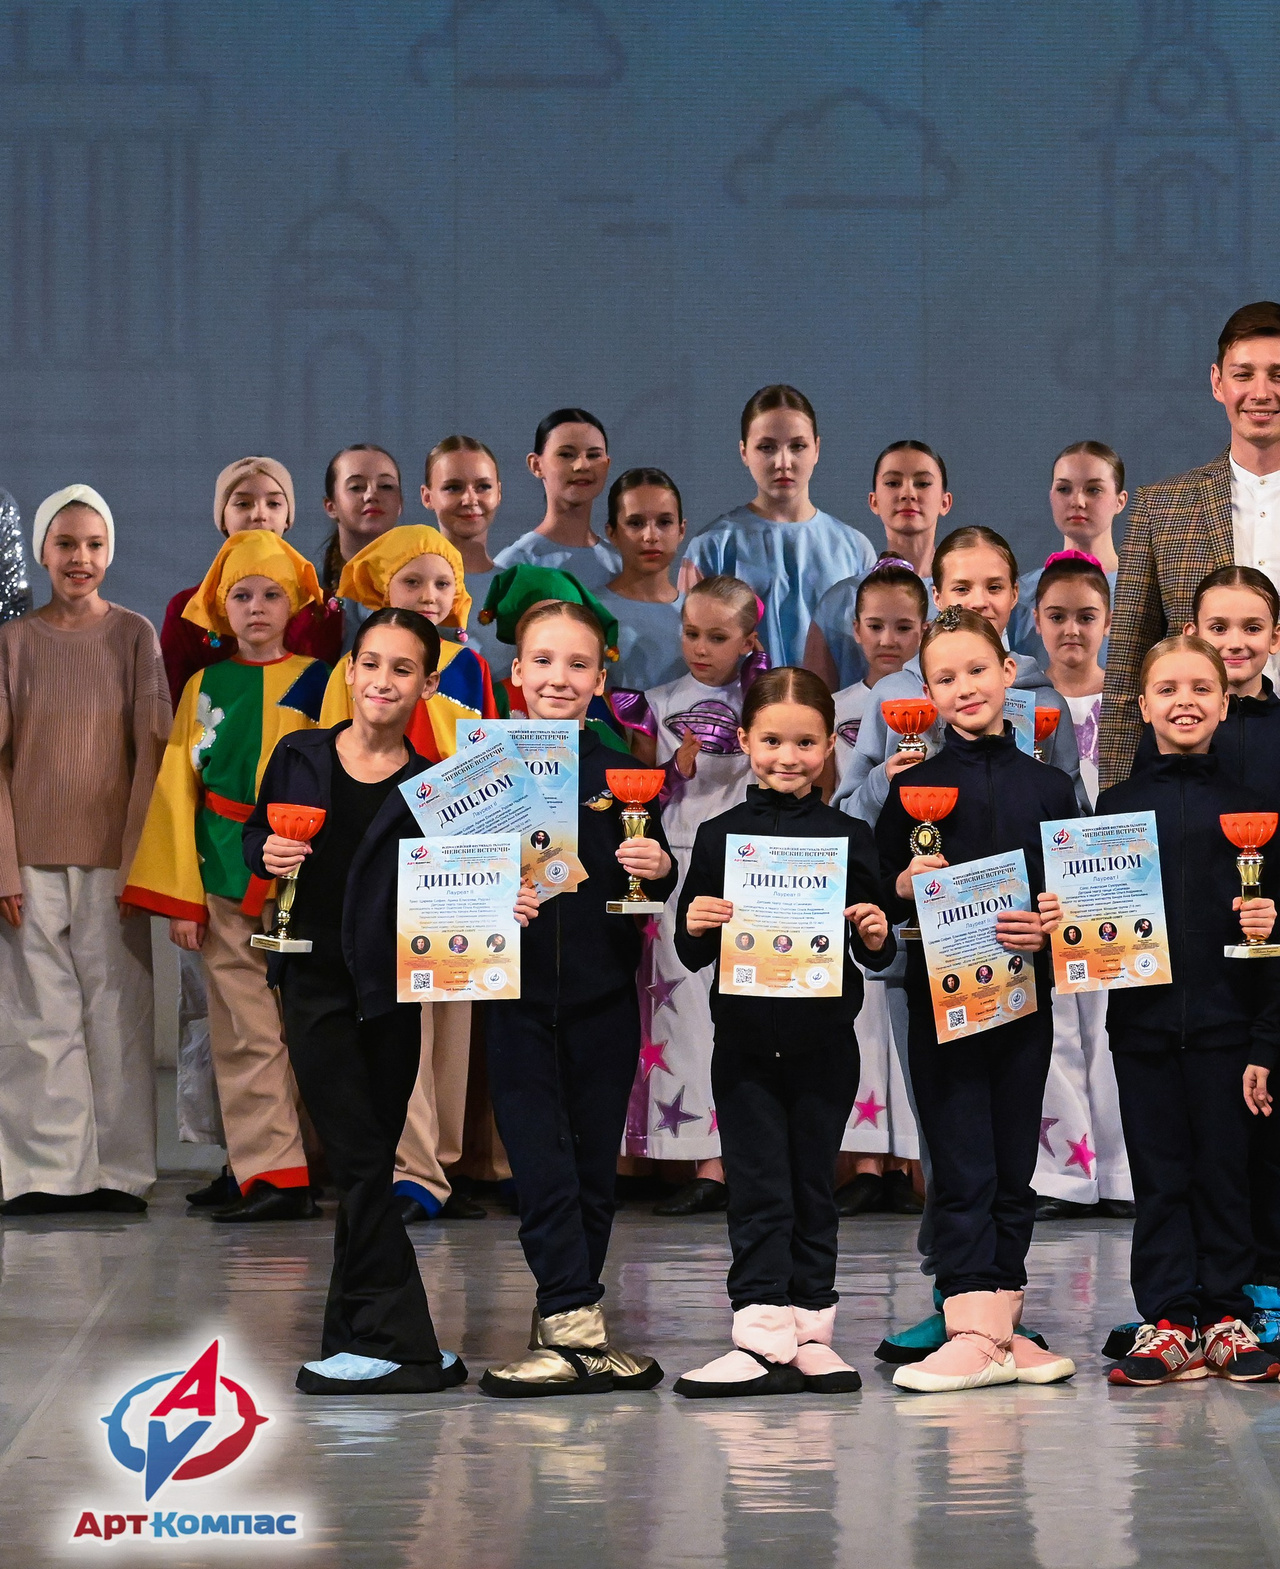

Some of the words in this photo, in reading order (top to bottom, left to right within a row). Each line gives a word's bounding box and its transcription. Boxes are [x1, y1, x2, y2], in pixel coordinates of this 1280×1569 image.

[436, 774, 514, 829] ДИПЛОМ
[472, 804, 494, 818] Лауреат
[1063, 854, 1142, 879] ДИПЛОМ
[416, 872, 500, 891] ДИПЛОМ
[742, 873, 828, 889] ДИПЛОМ
[937, 894, 1014, 929] ДИПЛОМ
[965, 920, 987, 929] Лауреат
[1161, 1343, 1186, 1371] N
[1208, 1340, 1232, 1367] N
